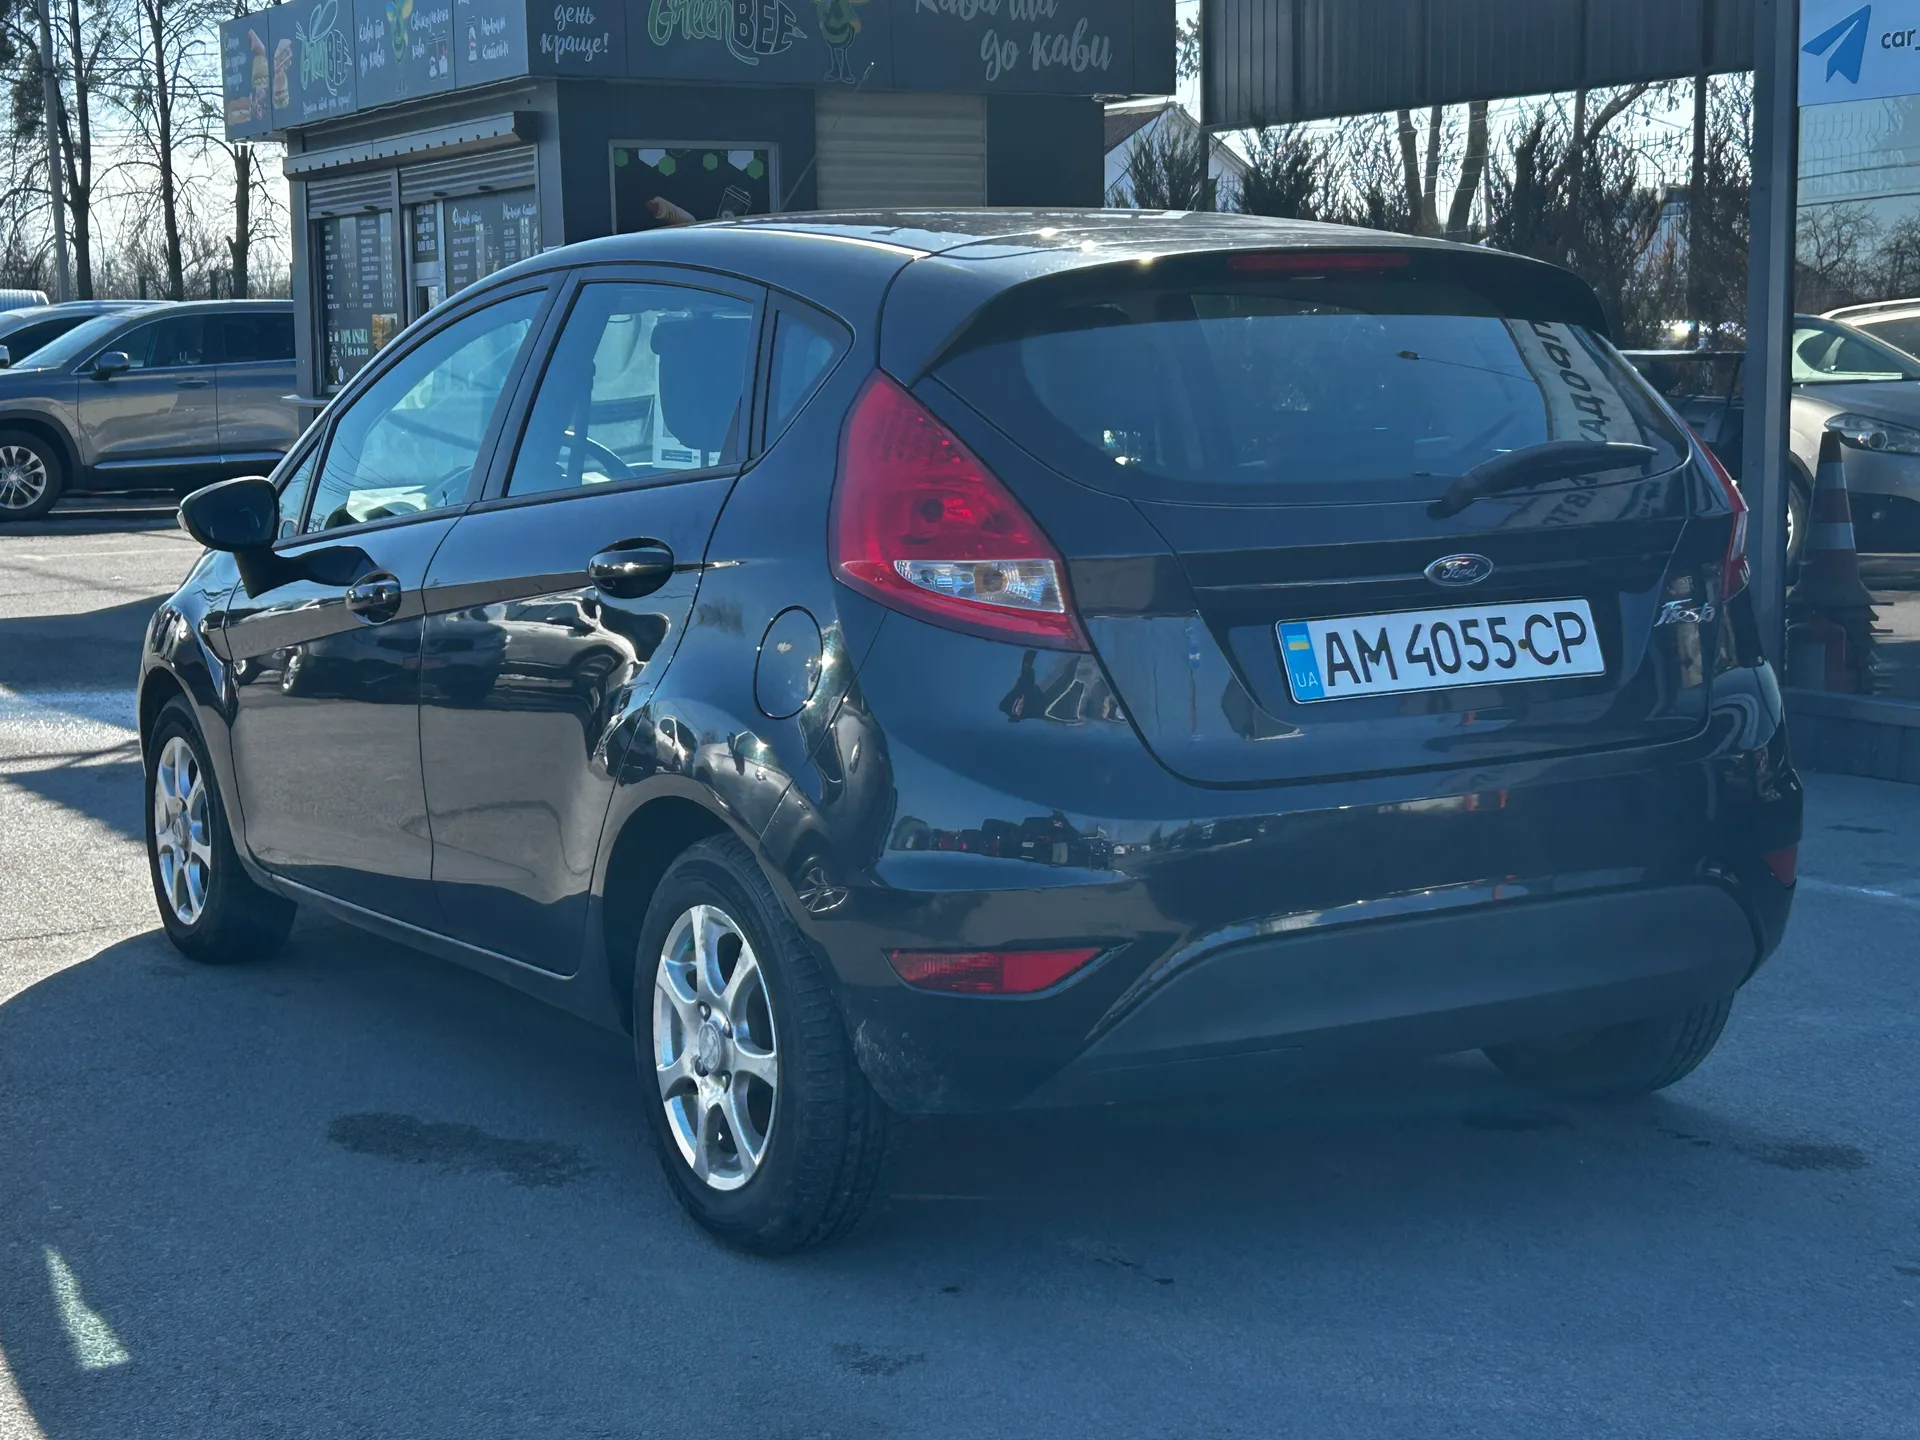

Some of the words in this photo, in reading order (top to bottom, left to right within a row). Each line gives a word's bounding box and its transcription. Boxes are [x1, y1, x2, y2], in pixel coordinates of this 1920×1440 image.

[554, 5, 596, 31] день
[540, 33, 609, 64] краще!
[981, 29, 1019, 81] до
[1029, 17, 1113, 72] кави
[1441, 558, 1478, 579] Ford
[1325, 627, 1398, 686] AM
[1405, 616, 1518, 676] 4055
[1525, 611, 1588, 665] CP
[1295, 670, 1320, 688] UA
